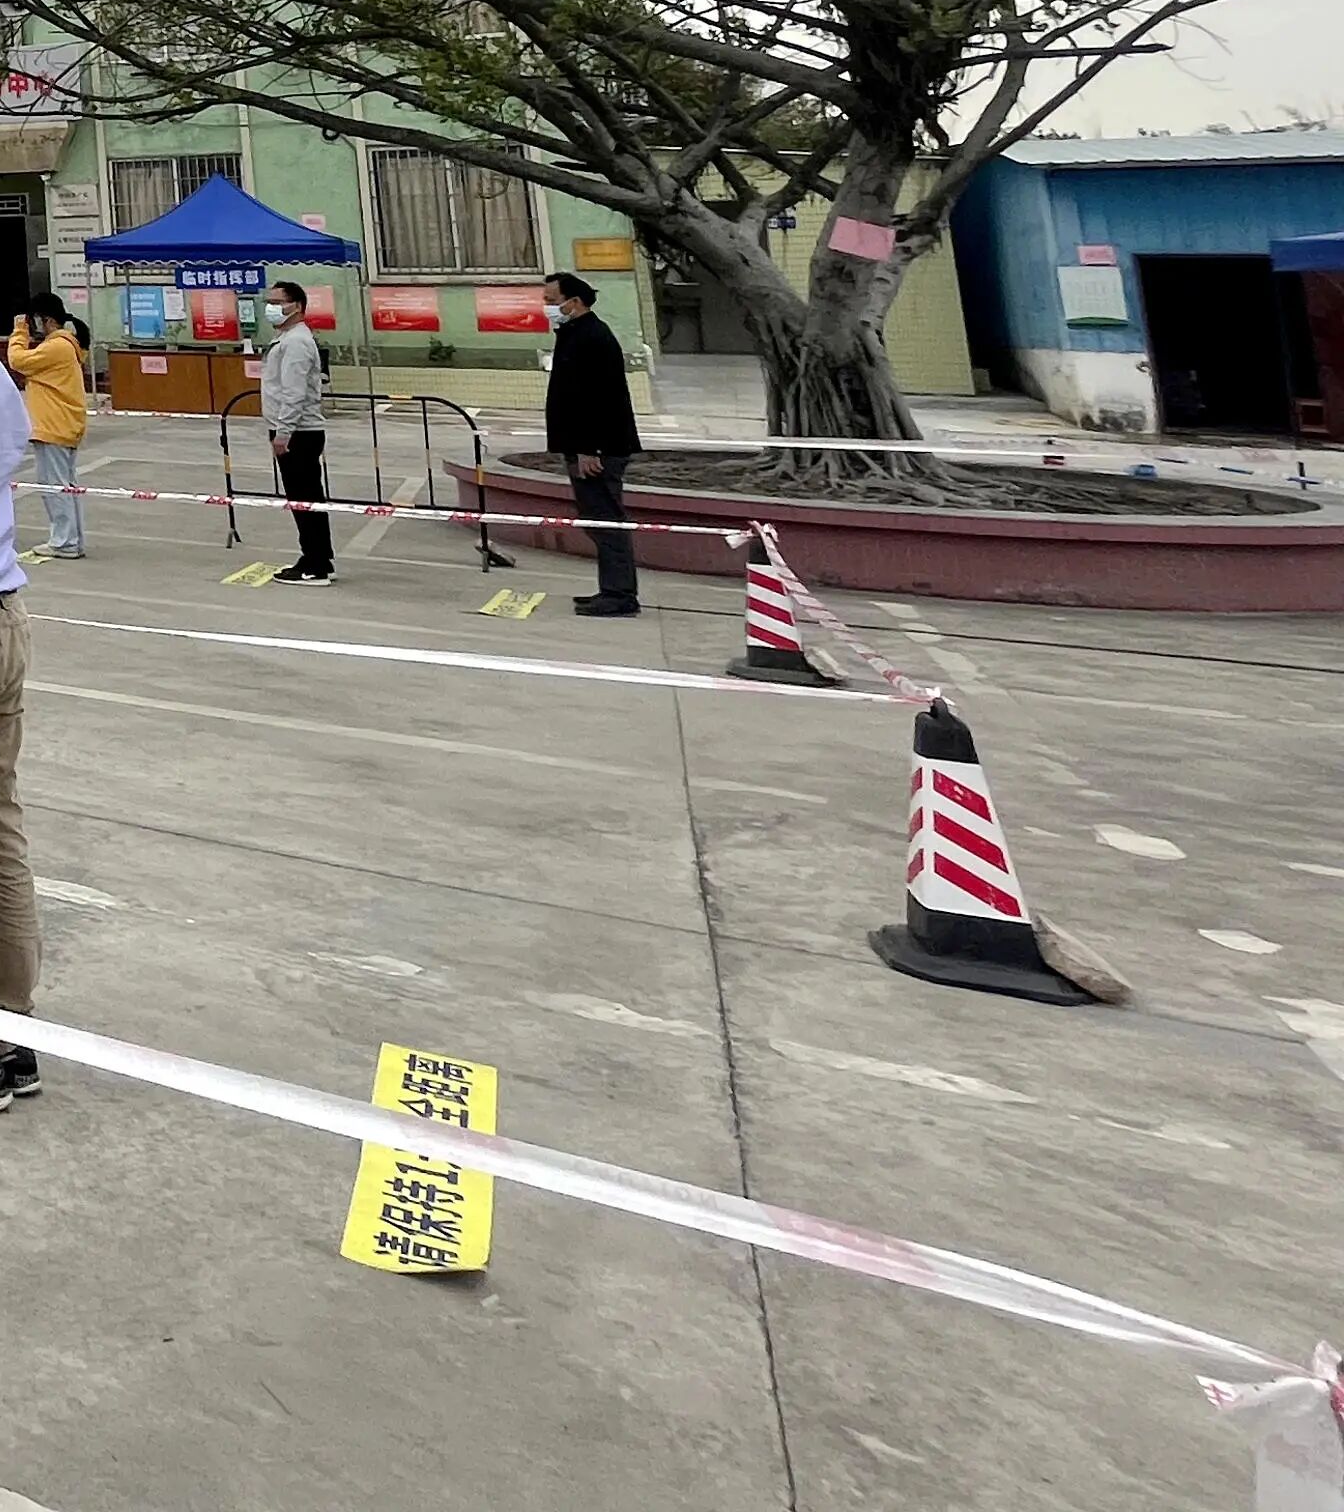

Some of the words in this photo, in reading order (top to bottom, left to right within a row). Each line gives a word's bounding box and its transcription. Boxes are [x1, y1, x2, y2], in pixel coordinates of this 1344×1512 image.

[182, 270, 259, 286] 临时指挥部
[373, 1053, 473, 1267] 请保持1全距离
